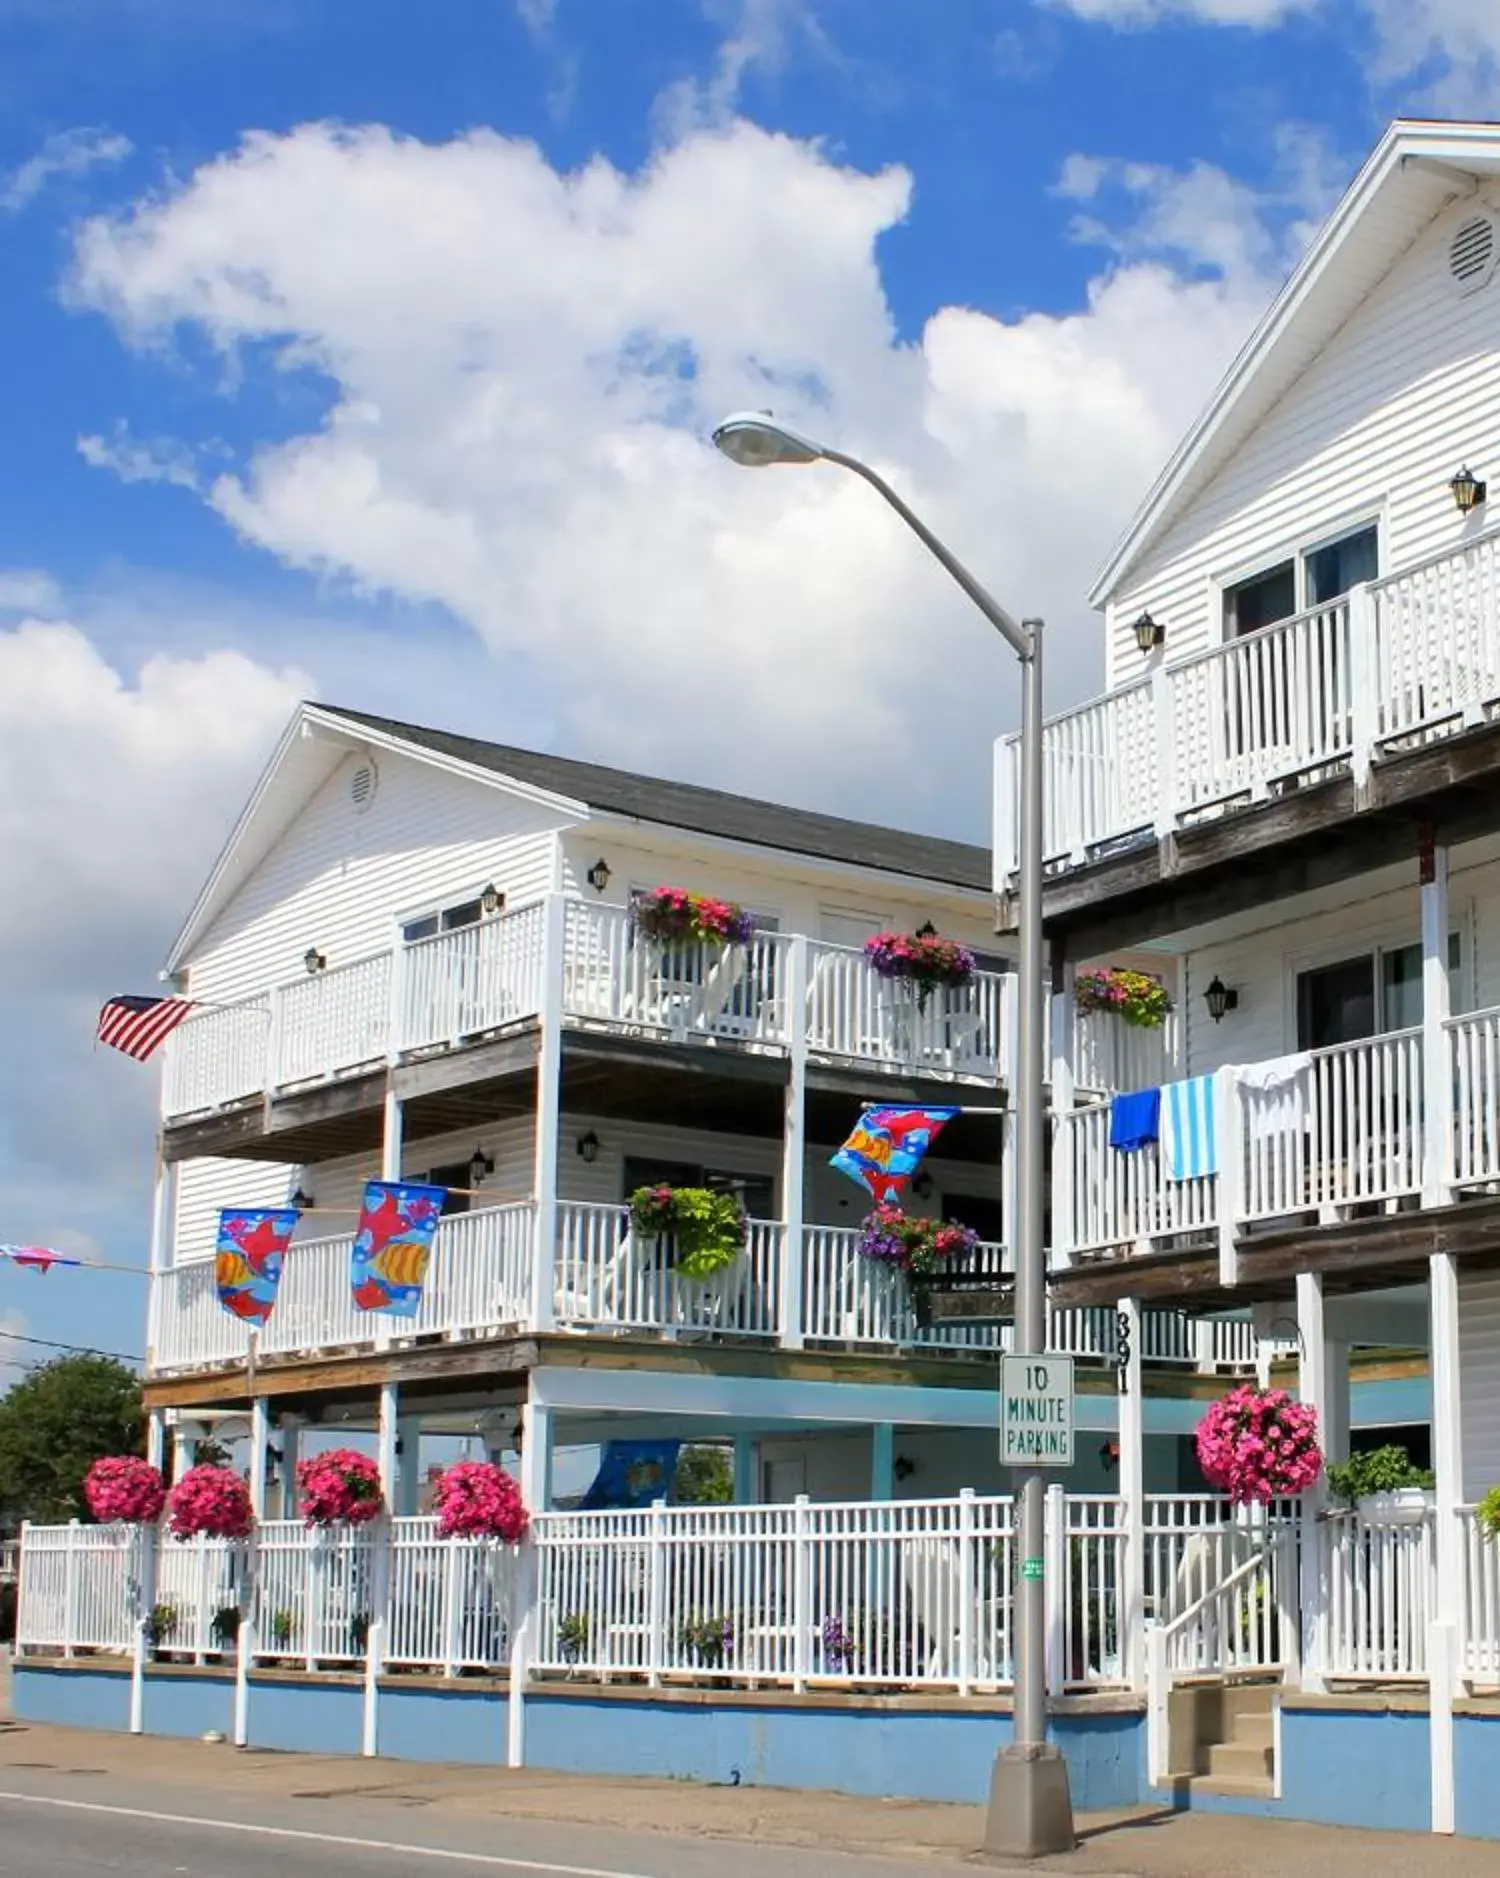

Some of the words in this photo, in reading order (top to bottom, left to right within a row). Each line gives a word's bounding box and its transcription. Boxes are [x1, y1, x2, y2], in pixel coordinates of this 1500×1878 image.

[1116, 1312, 1130, 1394] 391
[1026, 1366, 1048, 1390] 10
[1008, 1397, 1065, 1422] MINUTE
[1007, 1429, 1067, 1455] PARKING
